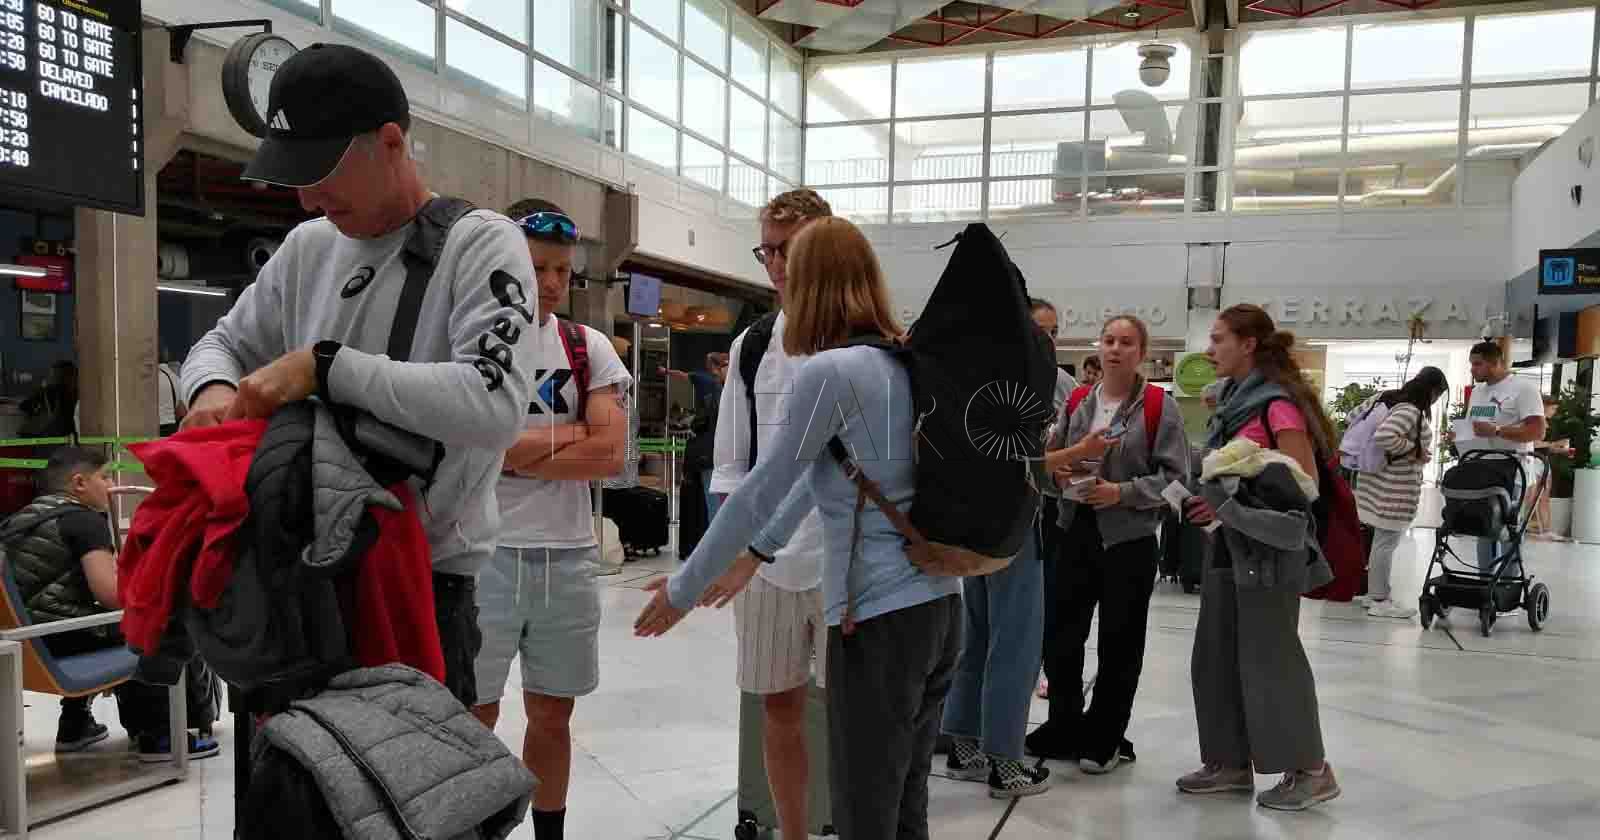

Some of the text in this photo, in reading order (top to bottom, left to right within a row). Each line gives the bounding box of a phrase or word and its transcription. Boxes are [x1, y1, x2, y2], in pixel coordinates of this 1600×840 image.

[38, 3, 113, 42] GO TO GATE
[38, 23, 113, 60] GO TO GATE
[39, 42, 114, 78] GO TO GATE
[39, 60, 94, 89] DELAYED
[40, 80, 109, 111] CANCELADO
